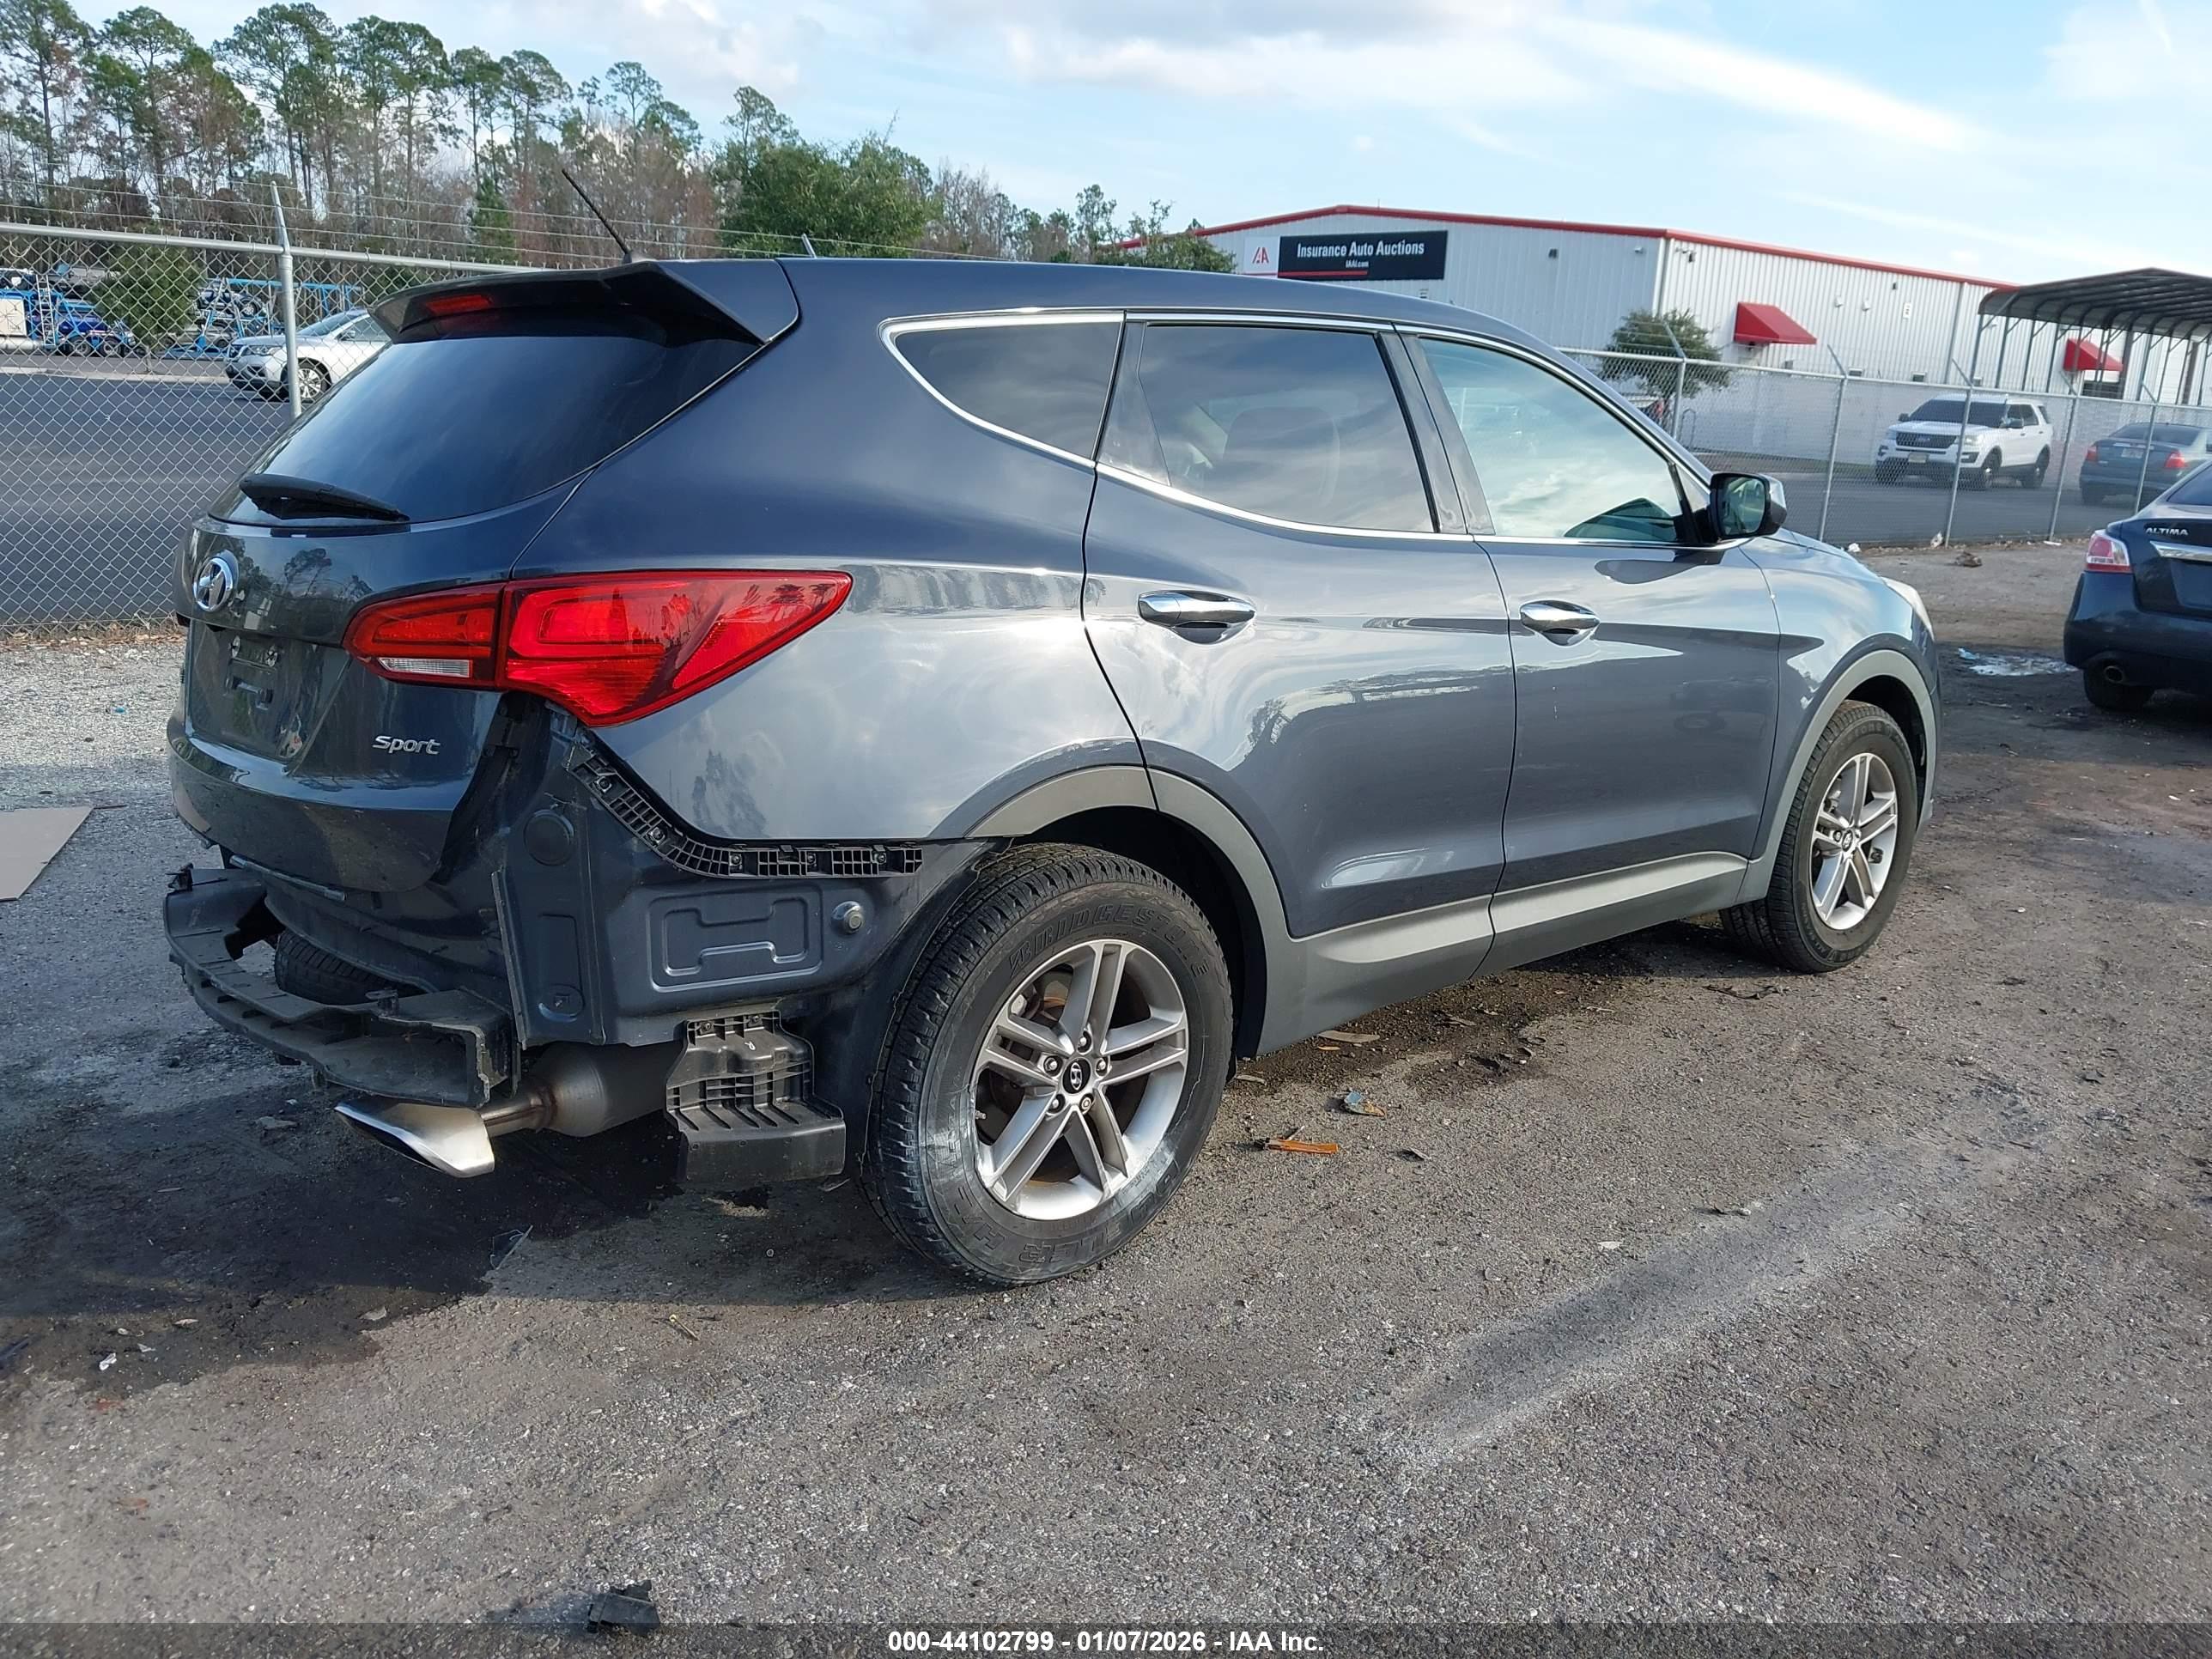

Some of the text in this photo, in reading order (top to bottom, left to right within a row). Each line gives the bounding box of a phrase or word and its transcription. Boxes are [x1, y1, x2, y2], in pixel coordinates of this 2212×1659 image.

[1297, 240, 1425, 258] Insurance Auto Auctions
[2146, 527, 2189, 536] ALTIMA
[372, 735, 441, 755] Sport
[1009, 903, 1209, 979] BRIDGESTONE
